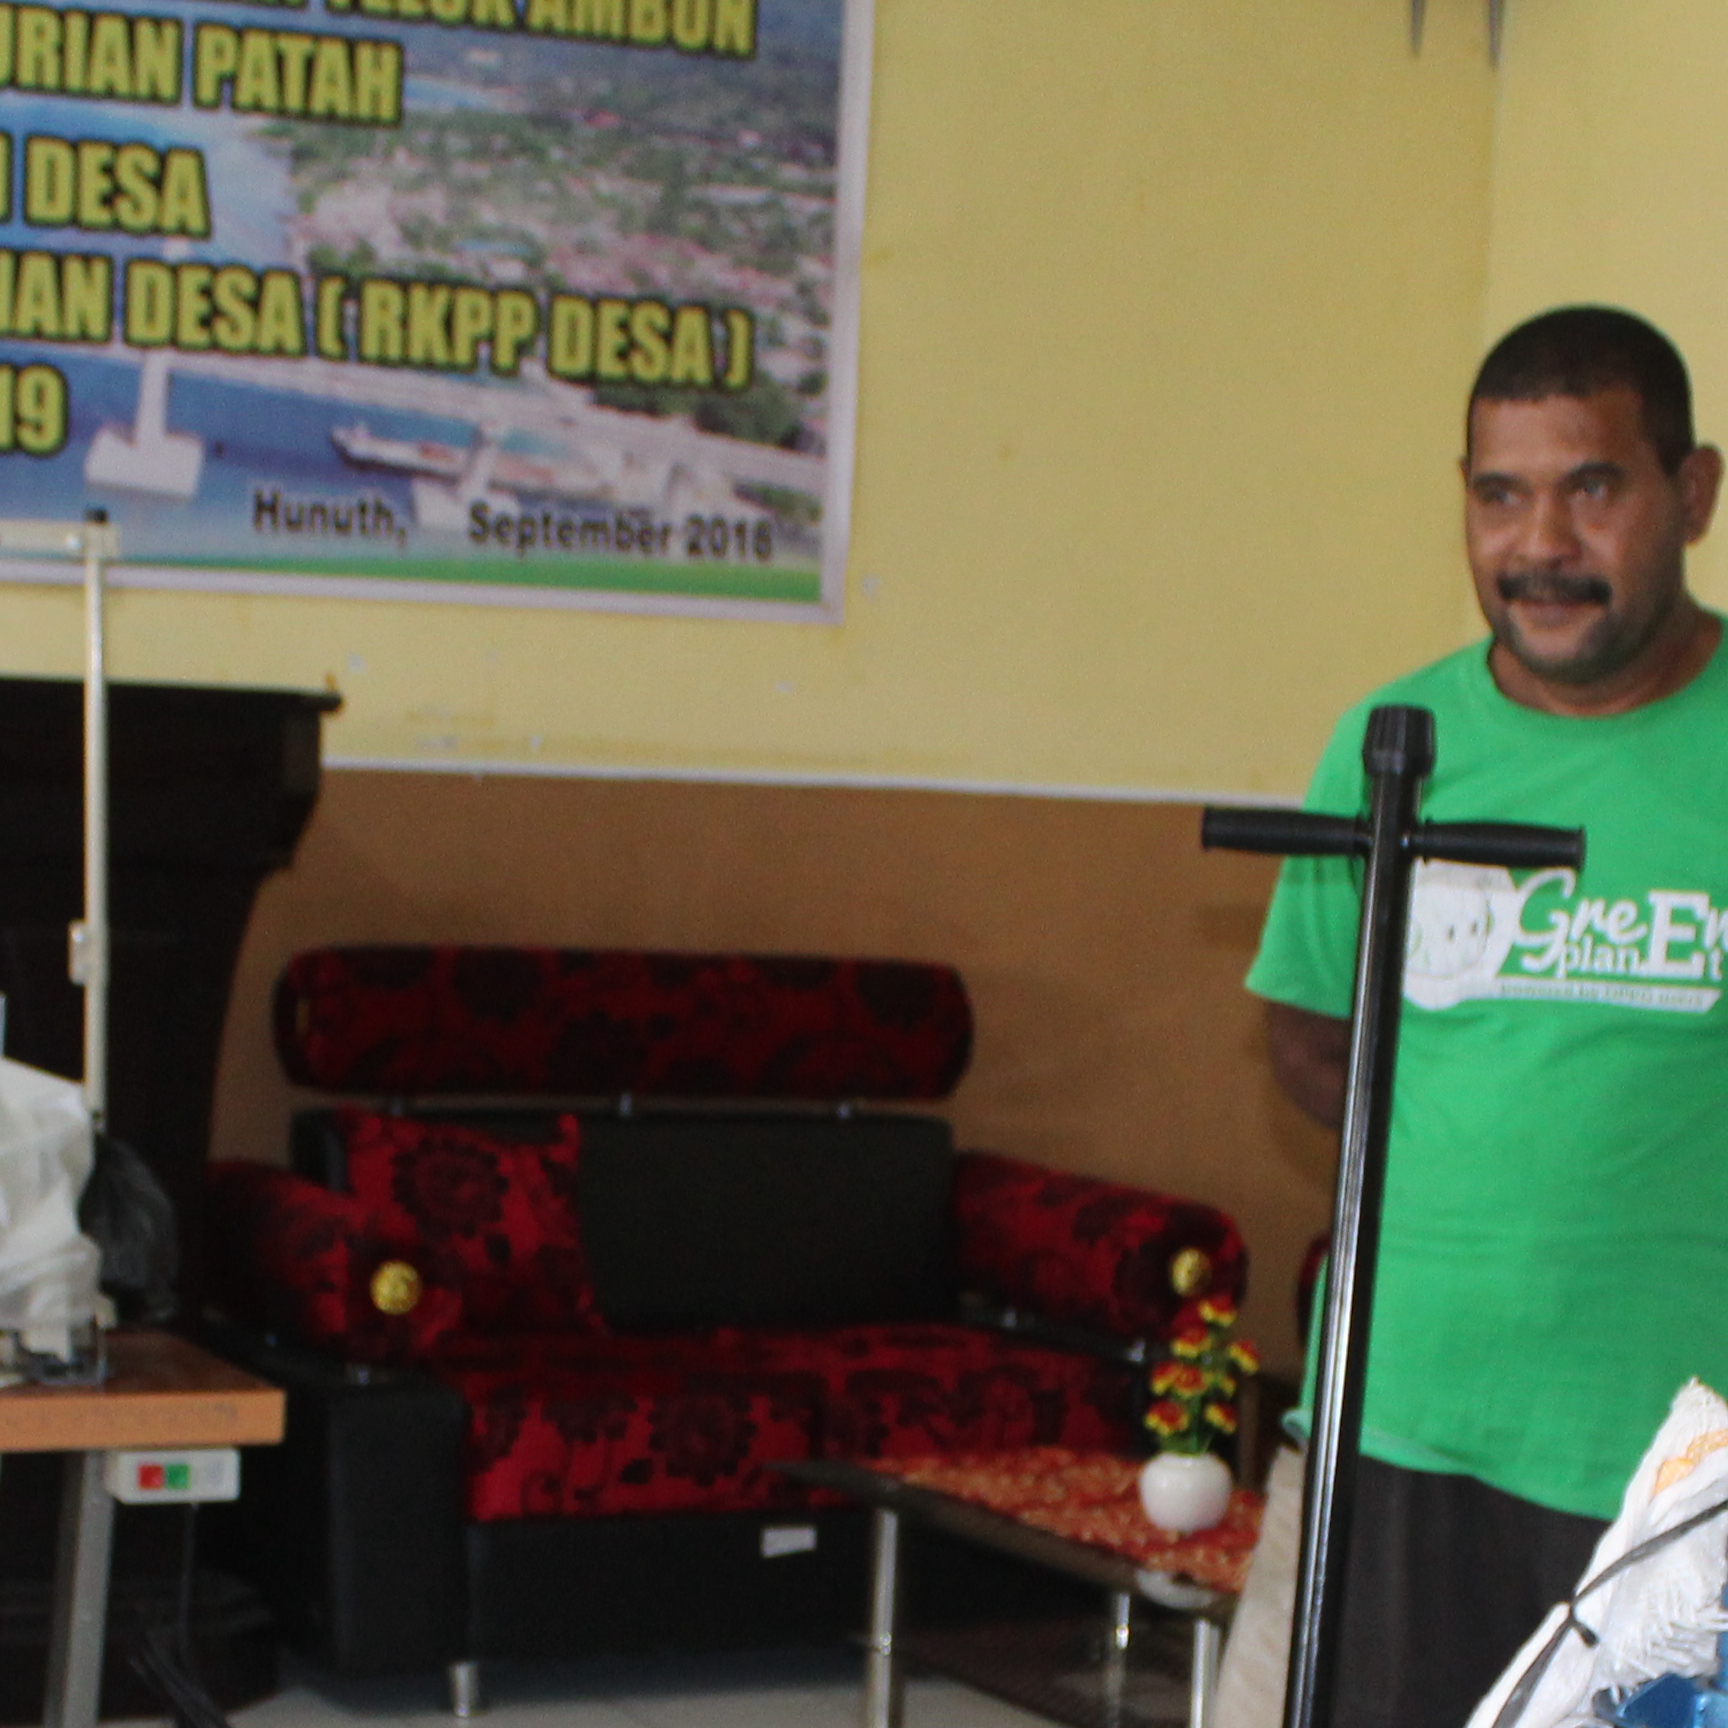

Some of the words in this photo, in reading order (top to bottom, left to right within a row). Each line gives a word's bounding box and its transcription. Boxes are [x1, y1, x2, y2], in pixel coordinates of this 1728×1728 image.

[192, 20, 404, 128] PATAH
[22, 134, 211, 240] DESA
[123, 255, 306, 358] DESA
[359, 277, 541, 377] RKPP
[545, 295, 716, 390] DESA
[252, 489, 406, 548] Hunuth,
[469, 502, 671, 558] September
